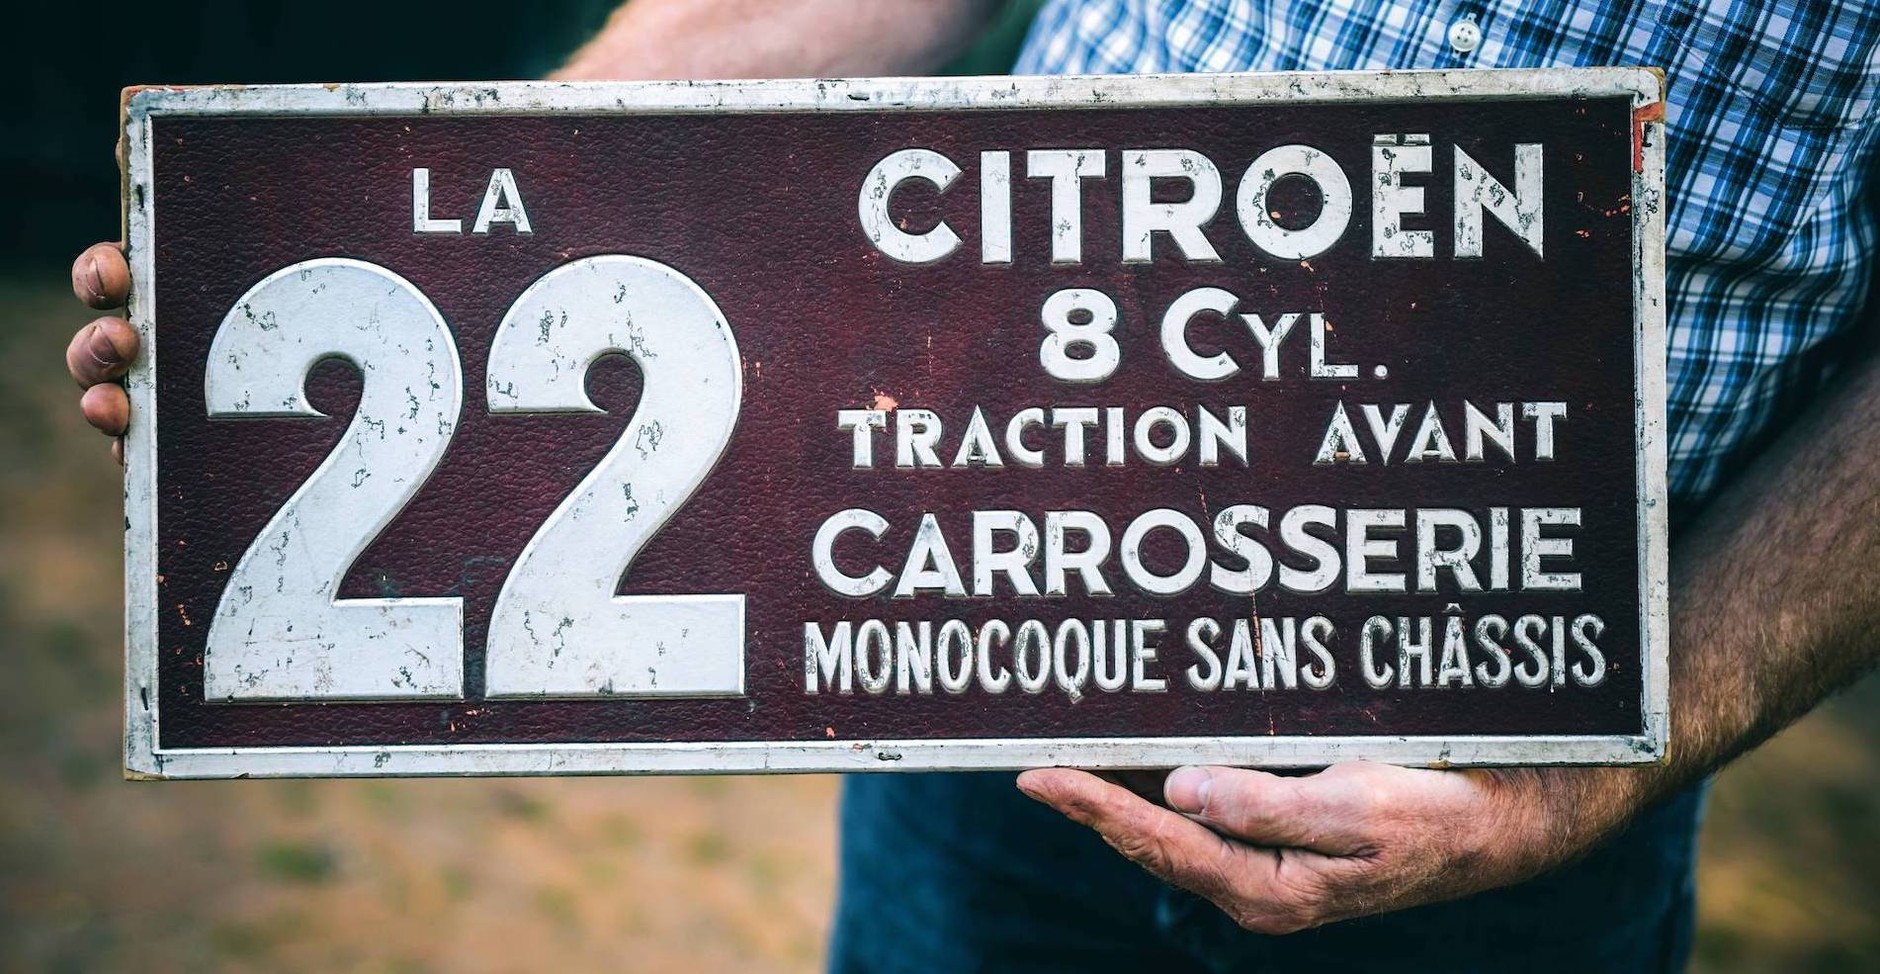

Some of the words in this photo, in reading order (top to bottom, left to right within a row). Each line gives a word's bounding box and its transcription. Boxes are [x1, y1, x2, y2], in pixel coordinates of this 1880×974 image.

[412, 167, 533, 236] LA
[857, 133, 1545, 264] CITROËN
[1039, 288, 1122, 383] 8
[204, 256, 746, 701] 22
[836, 403, 1250, 470] TRACTION
[1312, 400, 1568, 466] AVANT
[811, 504, 1583, 599] CARROSSERIE
[803, 618, 1168, 705] MONOCOQUE
[1185, 616, 1338, 692] SANS
[1360, 602, 1606, 690] CHÂSSIS
